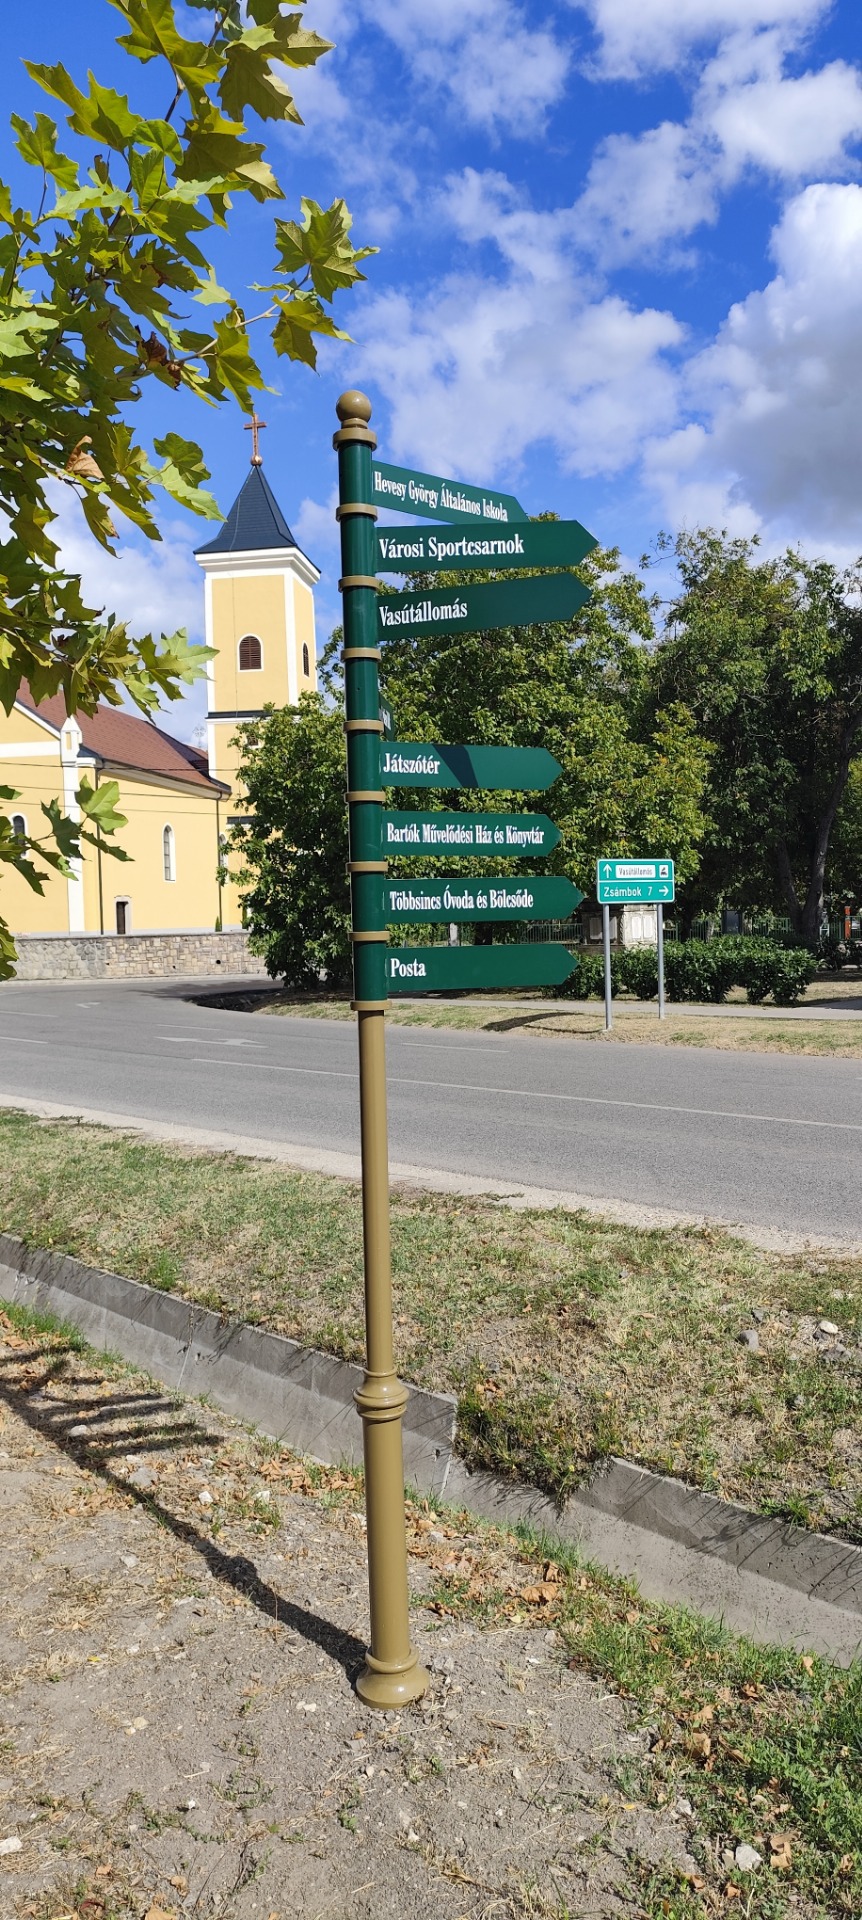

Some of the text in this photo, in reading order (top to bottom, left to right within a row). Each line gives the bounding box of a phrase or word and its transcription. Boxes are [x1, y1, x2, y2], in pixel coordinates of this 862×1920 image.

[374, 471, 508, 523] Hevesy György Általános Iskola
[379, 533, 524, 561] Városi Sportcsarnok
[379, 598, 468, 627] Vasútállomás
[383, 752, 440, 775] Játszótér
[387, 823, 545, 848] Bartók Művelődési Ház és Könyvtár
[390, 885, 534, 911] Többsincs Óvoda és Bölcsőde
[603, 886, 653, 897] Zsámbok 7
[390, 958, 426, 978] Posta
